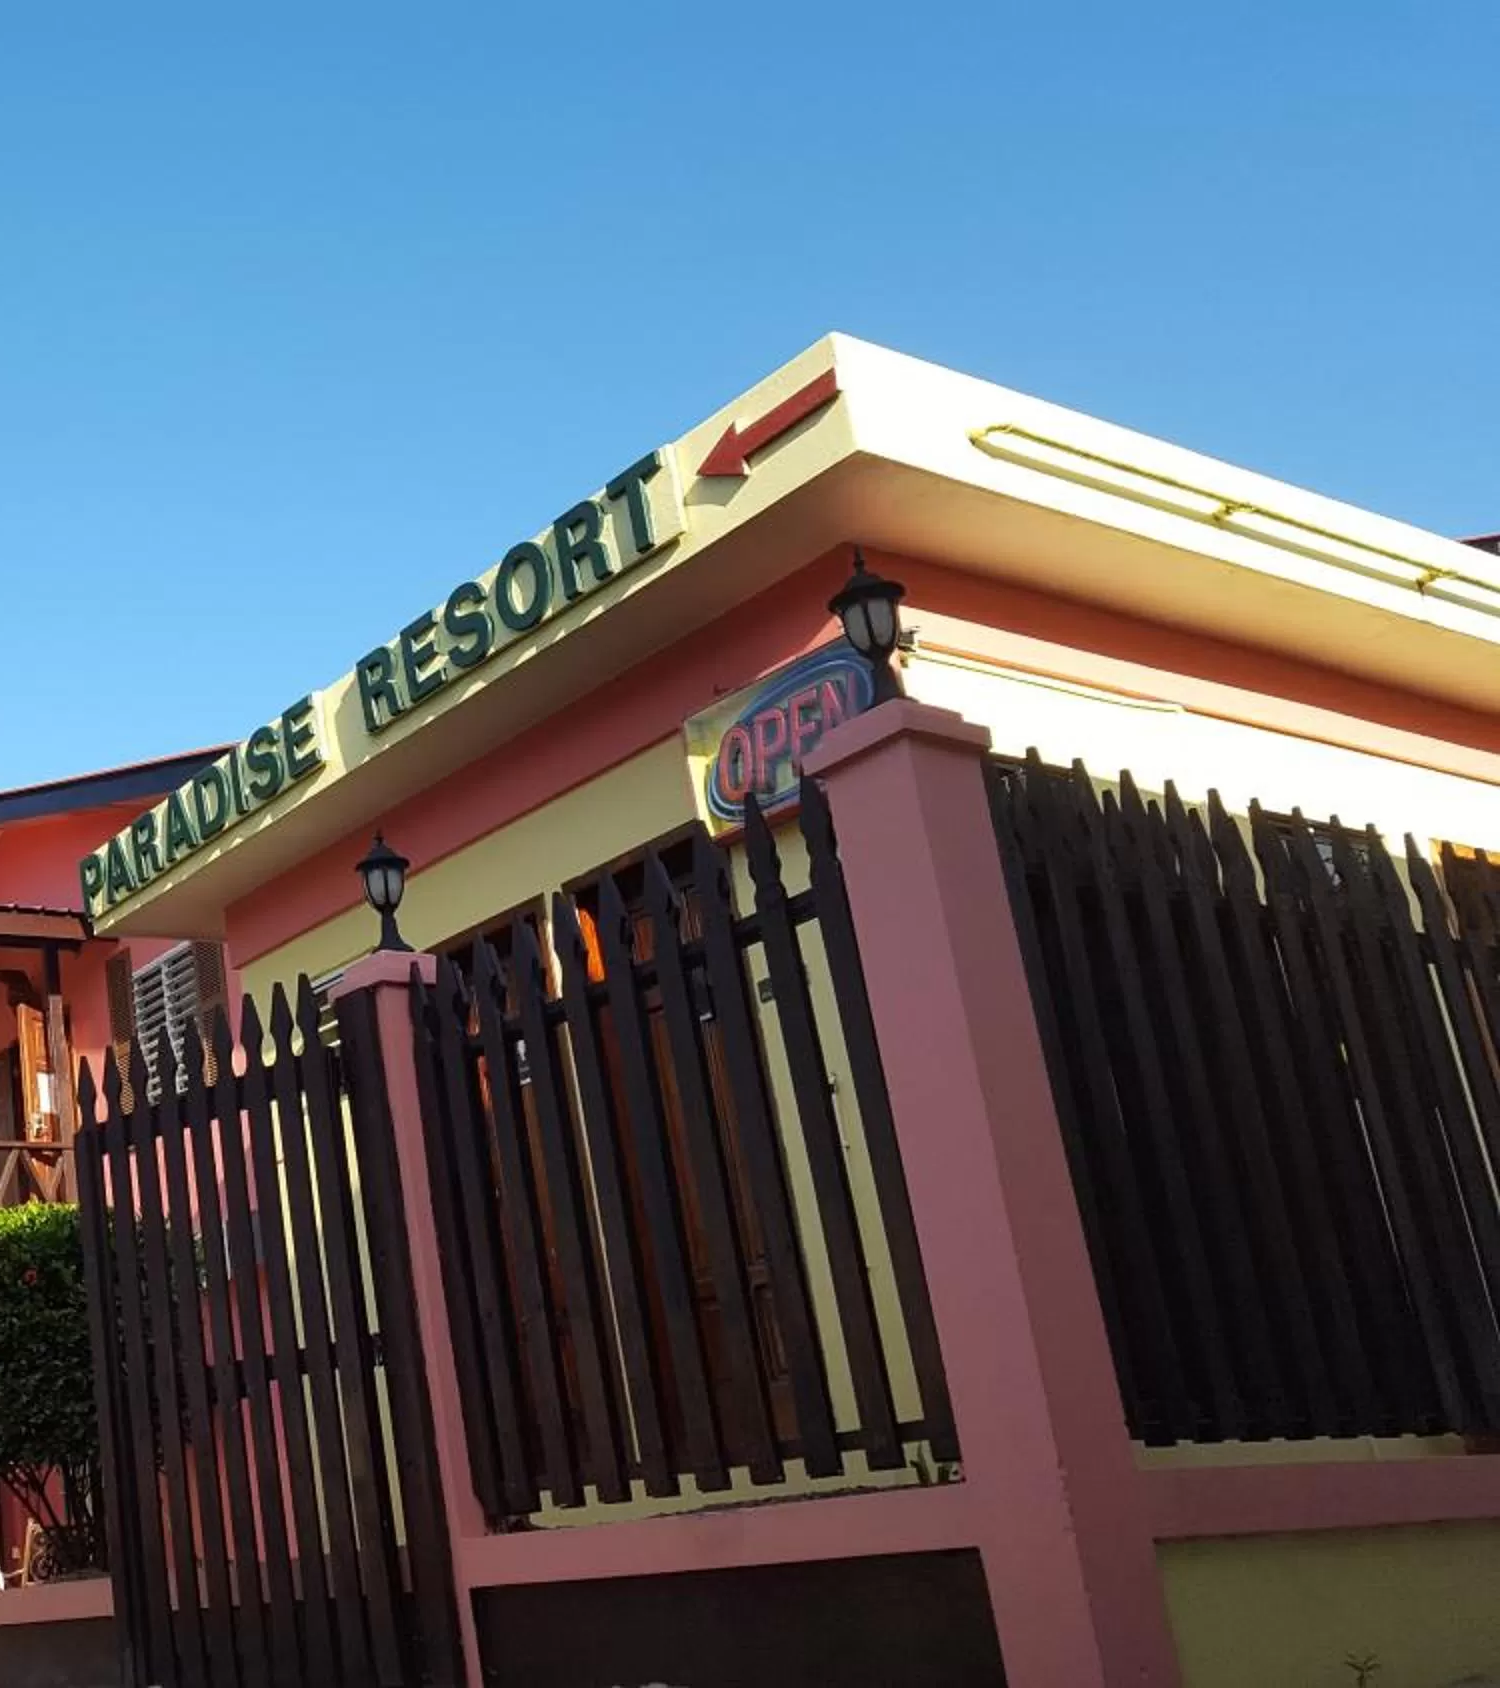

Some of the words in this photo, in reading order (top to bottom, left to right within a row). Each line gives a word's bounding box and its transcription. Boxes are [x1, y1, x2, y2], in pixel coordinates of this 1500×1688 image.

[79, 695, 323, 917] PARADISE
[356, 451, 660, 733] RESORT
[719, 671, 857, 801] OPEN
